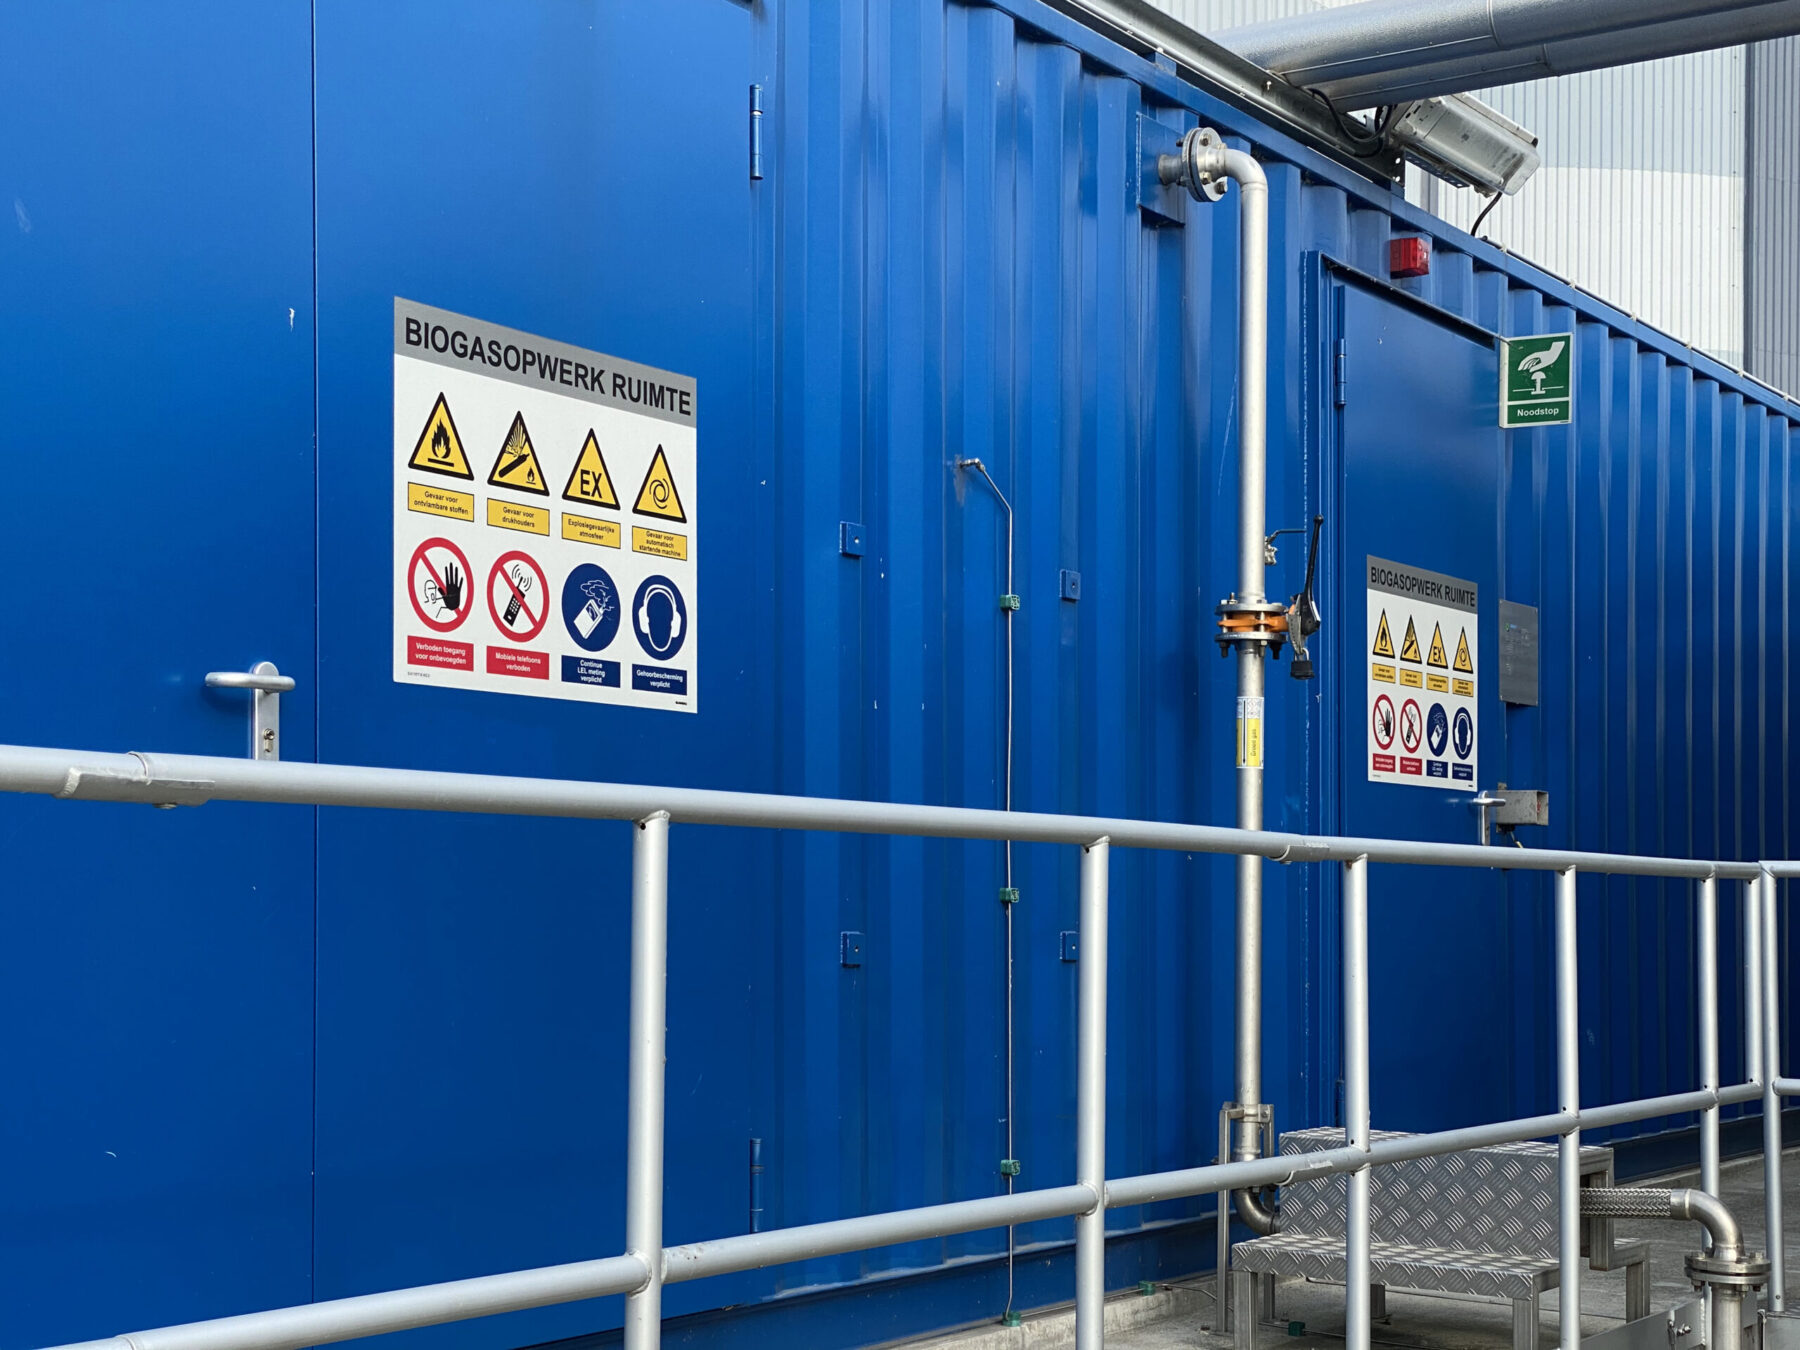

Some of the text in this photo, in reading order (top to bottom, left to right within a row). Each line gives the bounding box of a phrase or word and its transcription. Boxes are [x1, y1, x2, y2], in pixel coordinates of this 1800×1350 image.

[406, 318, 691, 416] BIOGASOPWERK RUIMTE
[1518, 408, 1560, 416] Noodstop
[580, 469, 602, 498] EX
[424, 491, 444, 500] Gevaar
[414, 500, 468, 515] ontvlambare stoffen
[503, 507, 521, 516] Gevaar
[502, 516, 535, 528] drukhouders
[568, 519, 614, 534] Explosiegevaarlijke
[579, 531, 604, 540] atmosfeer
[646, 531, 662, 539] Gevaar
[646, 539, 674, 548] automatisch
[639, 545, 680, 556] startende machine
[1371, 566, 1475, 607] BIOGASOPWERK RUIMTE
[416, 643, 466, 656] Verboden toegang
[1433, 646, 1442, 663] EX
[429, 655, 466, 664] onbevoegden
[496, 652, 541, 664] Mobiele telefoons
[506, 664, 530, 672] verboden
[580, 660, 602, 668] Continue
[588, 669, 605, 678] meting
[637, 670, 683, 682] Gehoorbescherming
